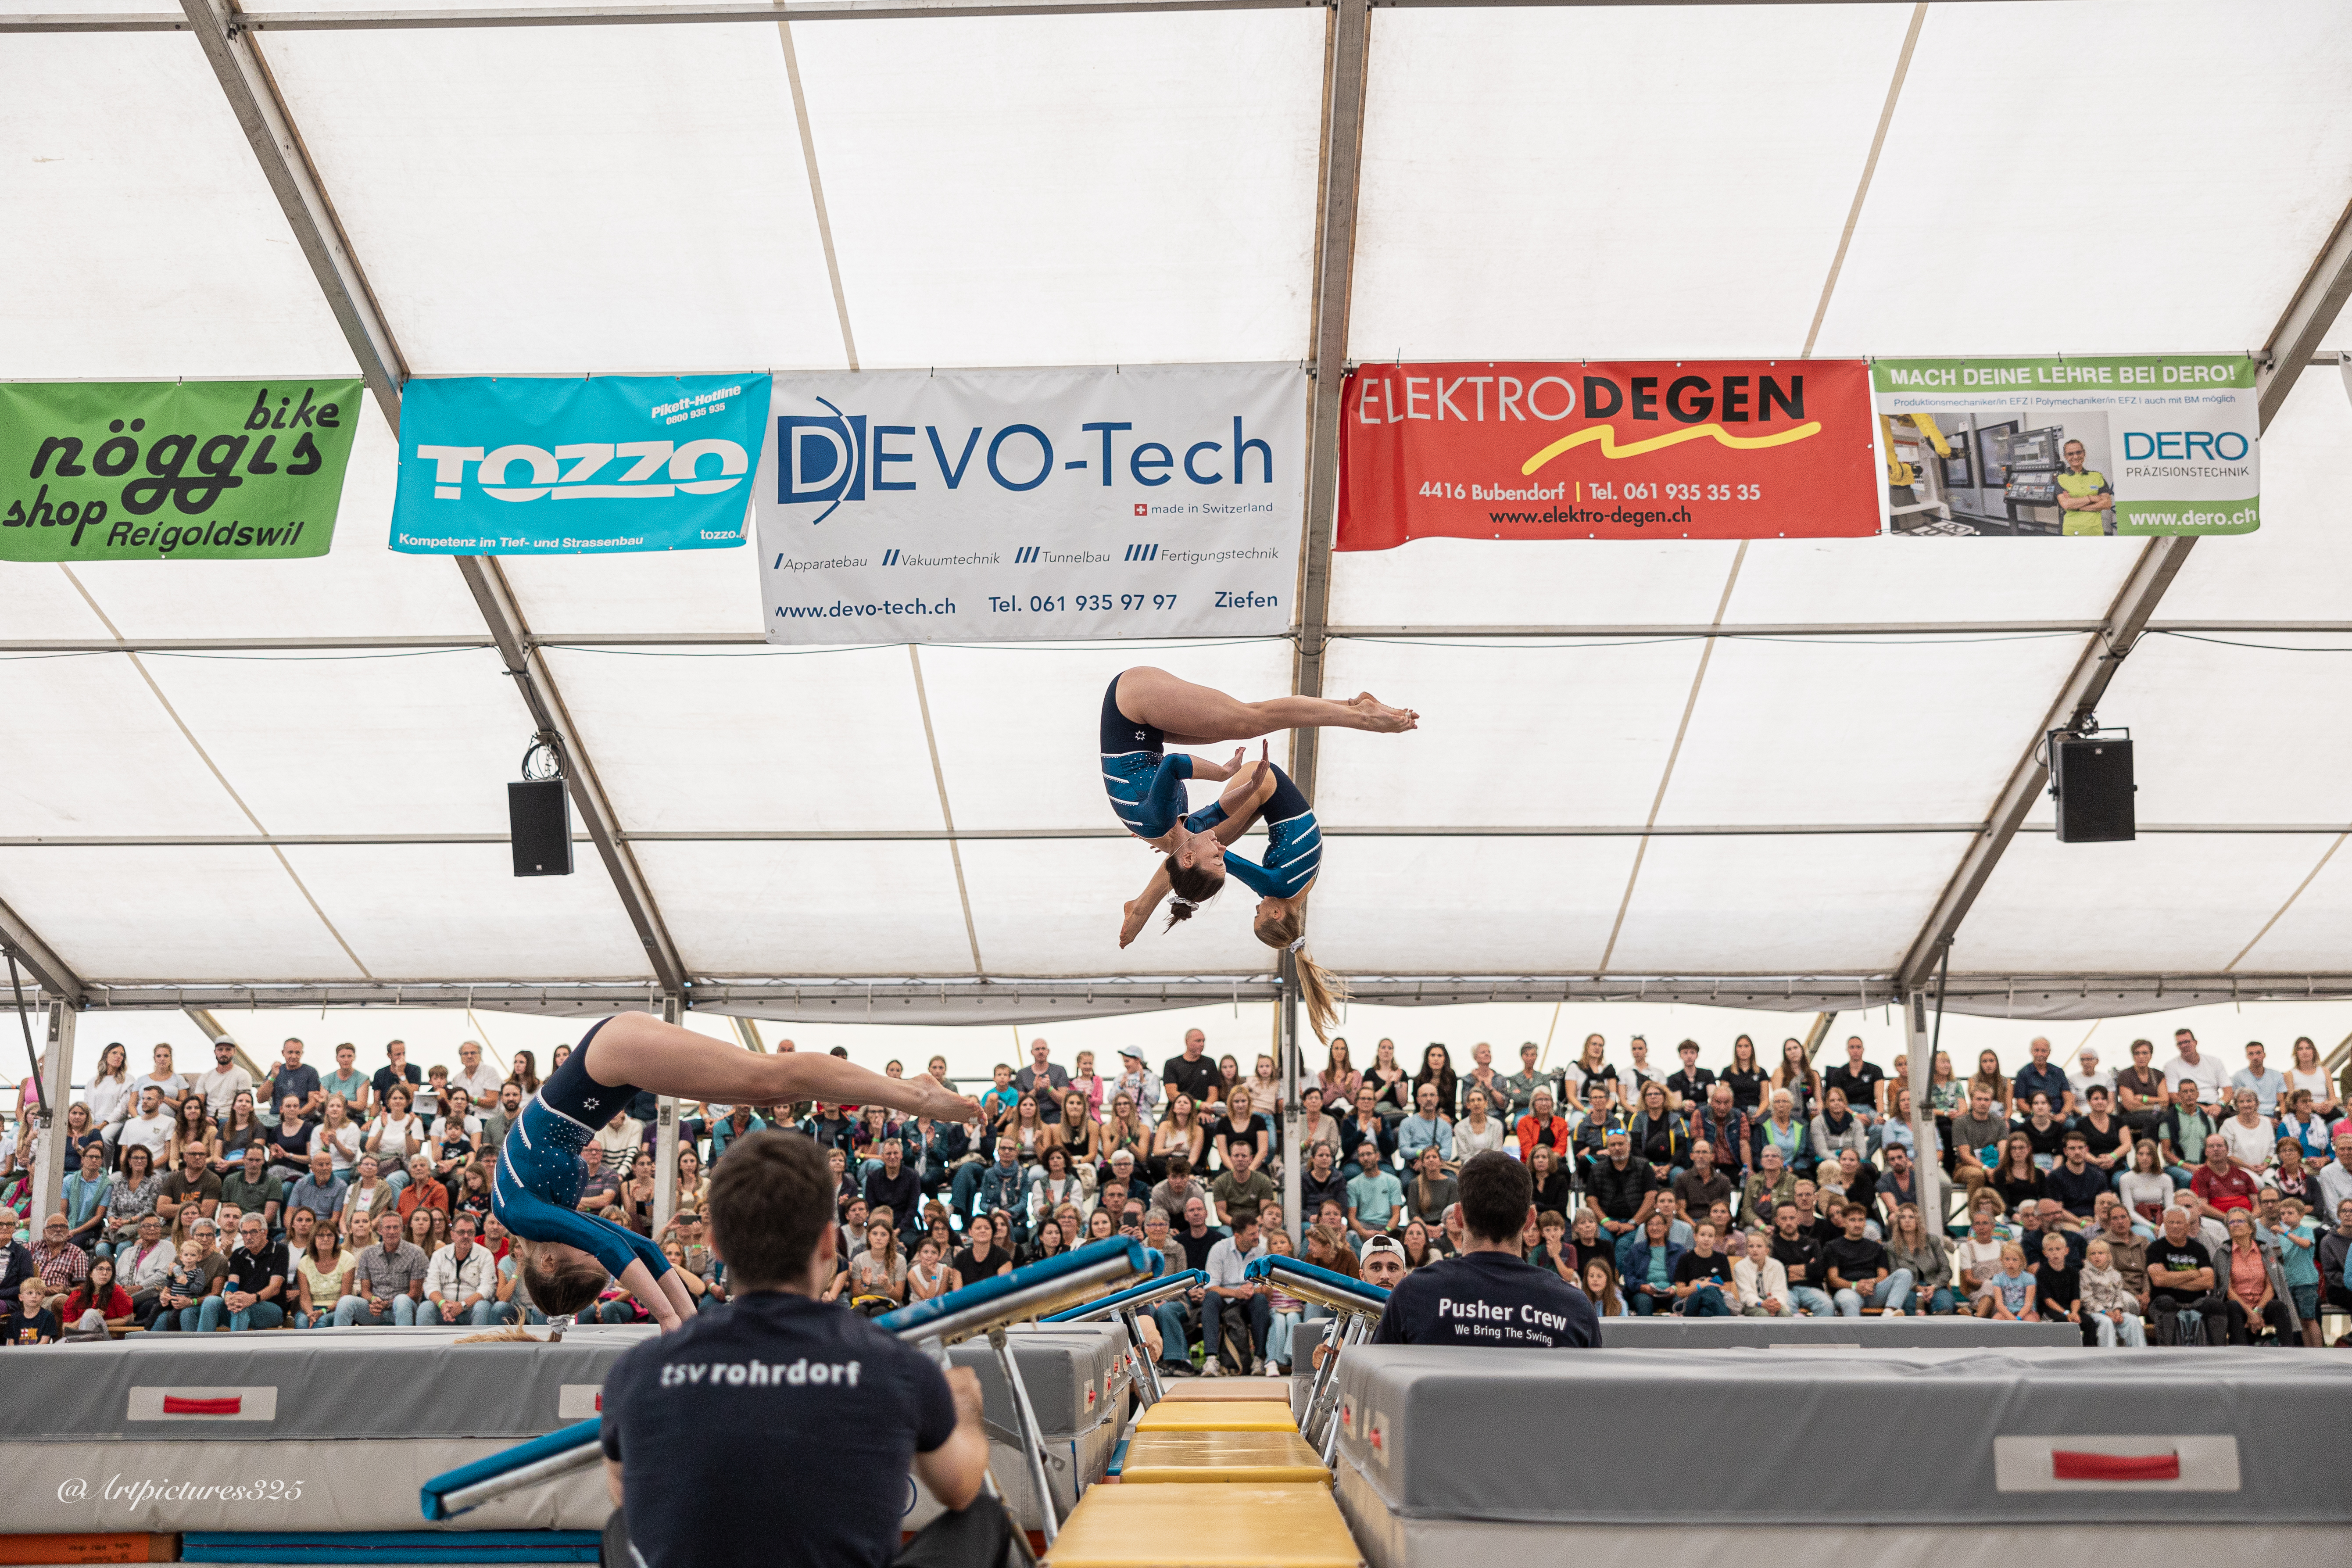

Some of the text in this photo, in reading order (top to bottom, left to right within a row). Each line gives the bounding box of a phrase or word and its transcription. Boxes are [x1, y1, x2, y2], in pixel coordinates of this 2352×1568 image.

[1890, 365, 2234, 386] MACH DEINE LEHRE BEI DERO!
[244, 387, 340, 430] bike
[651, 385, 741, 419] Pikett-Hotline
[2036, 397, 2115, 406] Polymechaniker/in
[2202, 395, 2235, 404] möglich
[666, 402, 726, 425] 0800 935 935
[2124, 432, 2248, 460] DERO
[417, 439, 748, 502] TOZZO
[2126, 467, 2249, 477] PRÄZISIONSTECHNIK
[1419, 481, 1760, 500] 4416 Bubendorf Tel. 061 935 35 35
[3, 484, 107, 547] shop
[1152, 503, 1273, 513] made in Switzerland
[1489, 505, 1691, 527] www.elektro-degen.ch
[2129, 508, 2256, 525] www.dero.ch
[107, 521, 304, 552] Reigoldswil
[399, 533, 643, 548] Kompetenz im Tief- und Strassenbau
[784, 548, 1278, 573] Apparatebau Vakuumtechnik Tunnelbau Fertigungstechnik
[775, 591, 1277, 618] www.devo-tech.ch Tel. 061 935 97 97 Ziefen
[1439, 1299, 1567, 1331] Pusher Crew
[1455, 1325, 1553, 1346] We Bring The Swing
[661, 1358, 861, 1387] tsv rohrdorf
